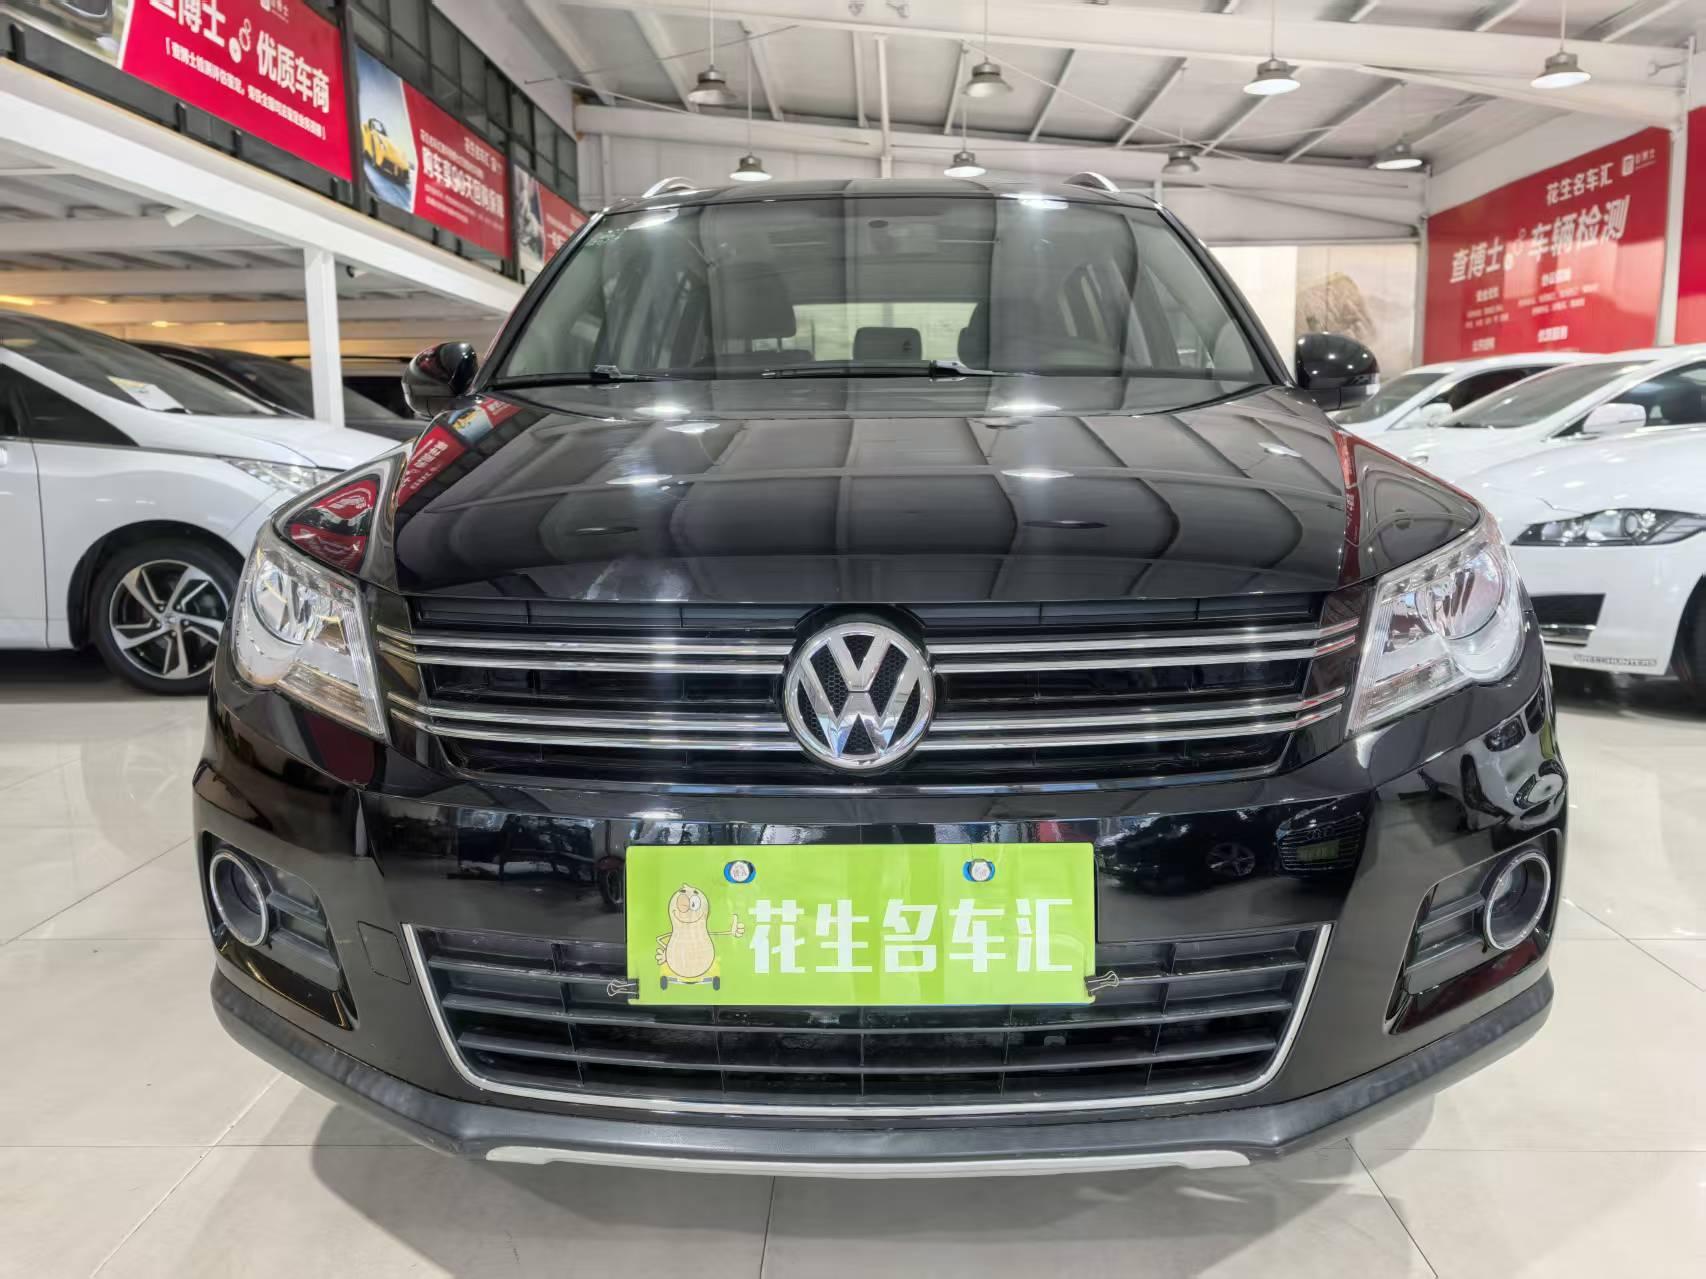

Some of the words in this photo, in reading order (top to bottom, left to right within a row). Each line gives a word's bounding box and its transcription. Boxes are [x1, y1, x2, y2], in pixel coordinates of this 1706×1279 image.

[149, 0, 226, 47] 博士
[256, 30, 331, 114] 优质车商
[1546, 162, 1614, 206] 花生名车汇
[1449, 237, 1505, 284] 查博士
[1529, 194, 1631, 263] 车辆检测
[793, 630, 927, 760] VW
[748, 898, 1073, 974] 花生名车汇
